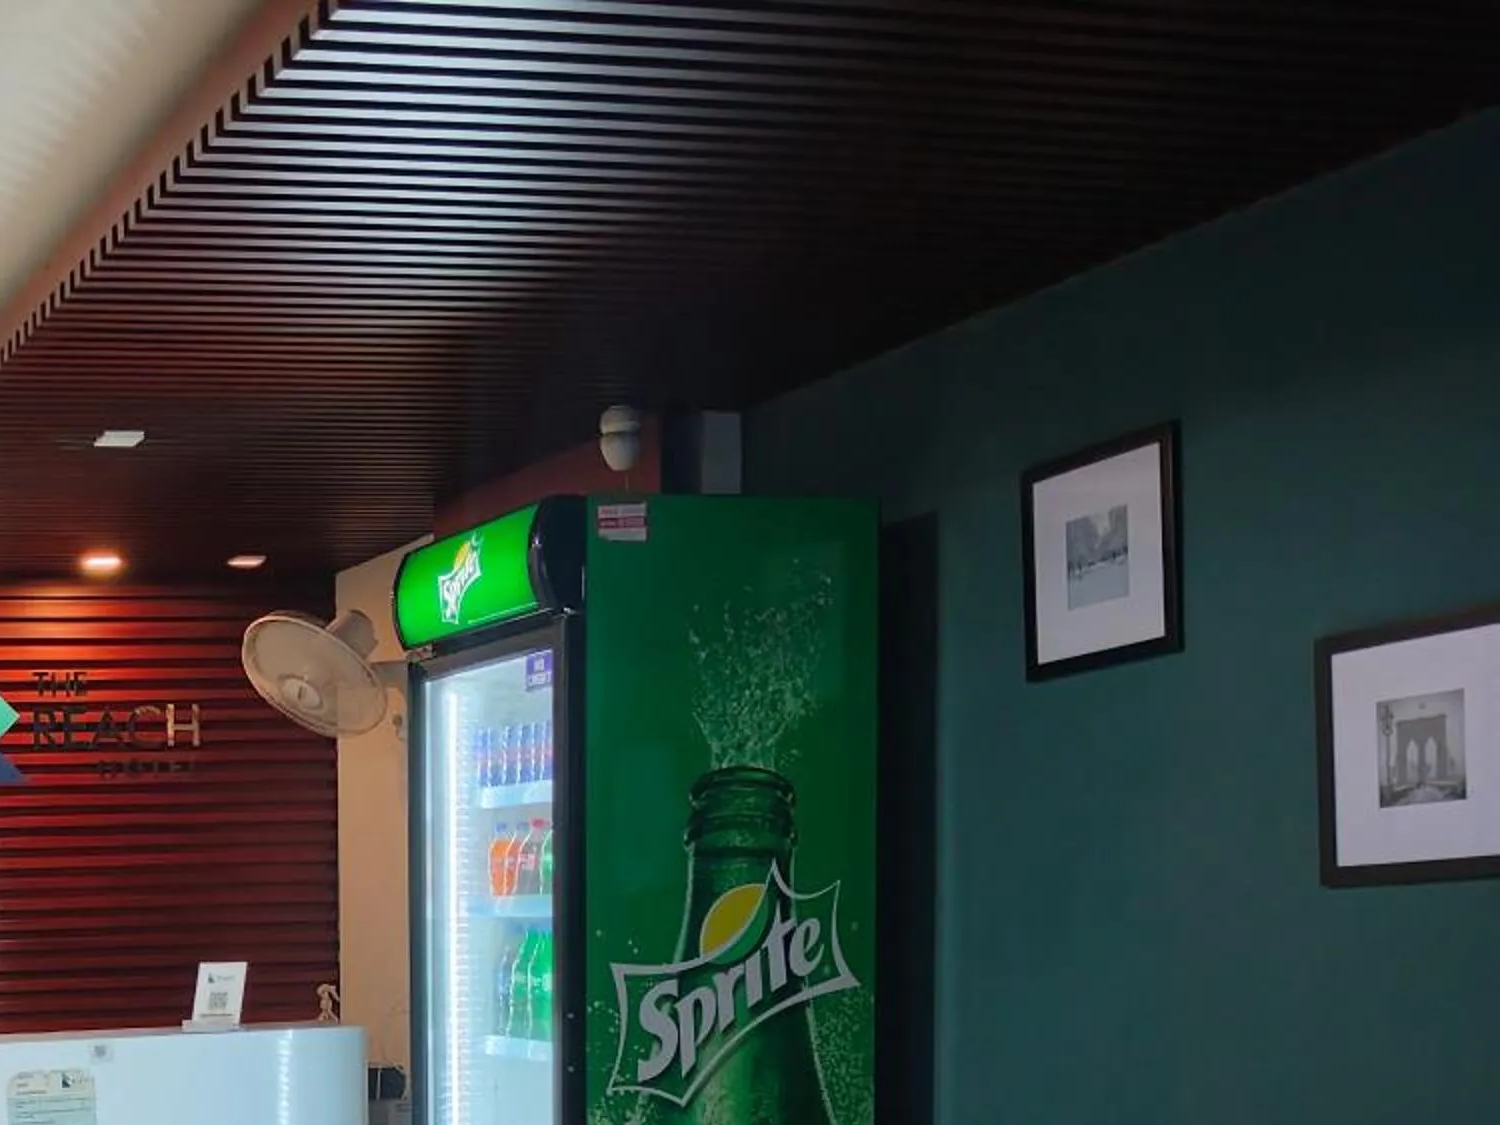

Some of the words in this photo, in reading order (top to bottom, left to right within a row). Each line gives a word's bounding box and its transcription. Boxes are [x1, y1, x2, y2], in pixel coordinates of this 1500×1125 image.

[32, 672, 88, 697] THE
[31, 703, 202, 751] REACH
[636, 900, 825, 1084] Sprite
